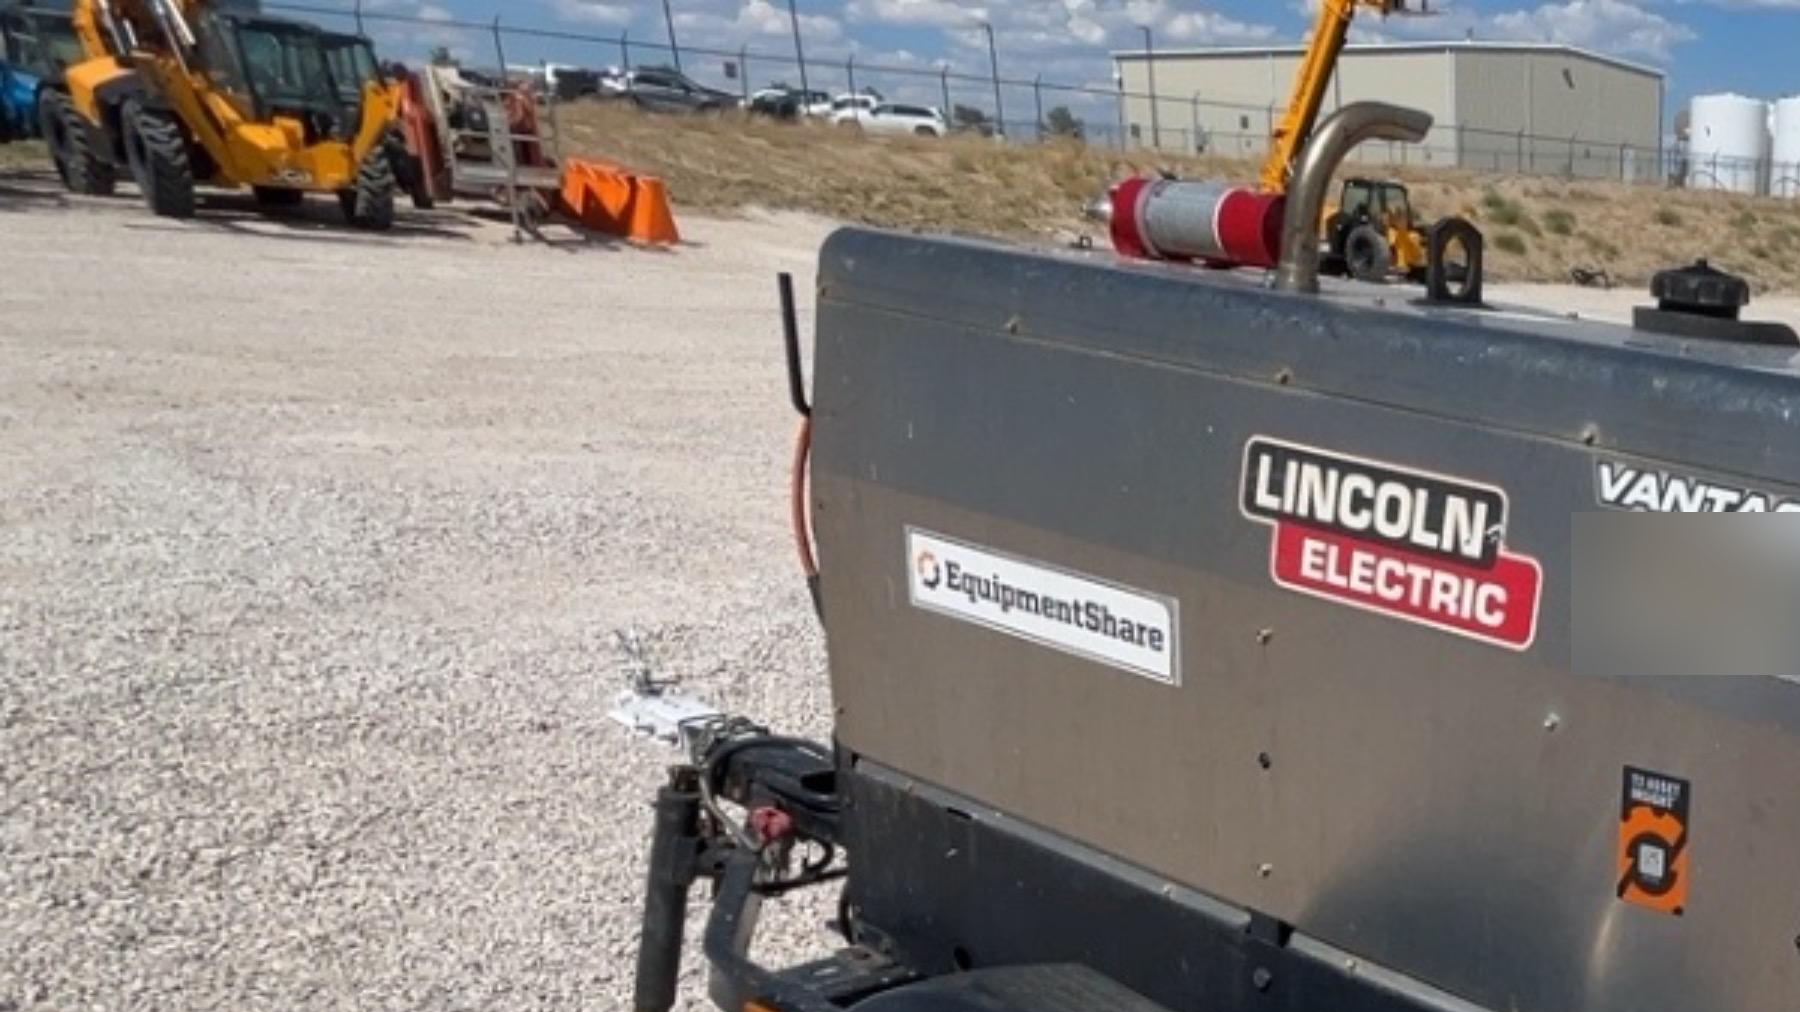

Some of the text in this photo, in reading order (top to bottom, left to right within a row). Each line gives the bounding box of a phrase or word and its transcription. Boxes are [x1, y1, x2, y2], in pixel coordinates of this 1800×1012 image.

[1254, 453, 1489, 559] LINCOLN
[944, 560, 1165, 652] EquipmentShare
[1299, 537, 1508, 628] ELECTRIC
